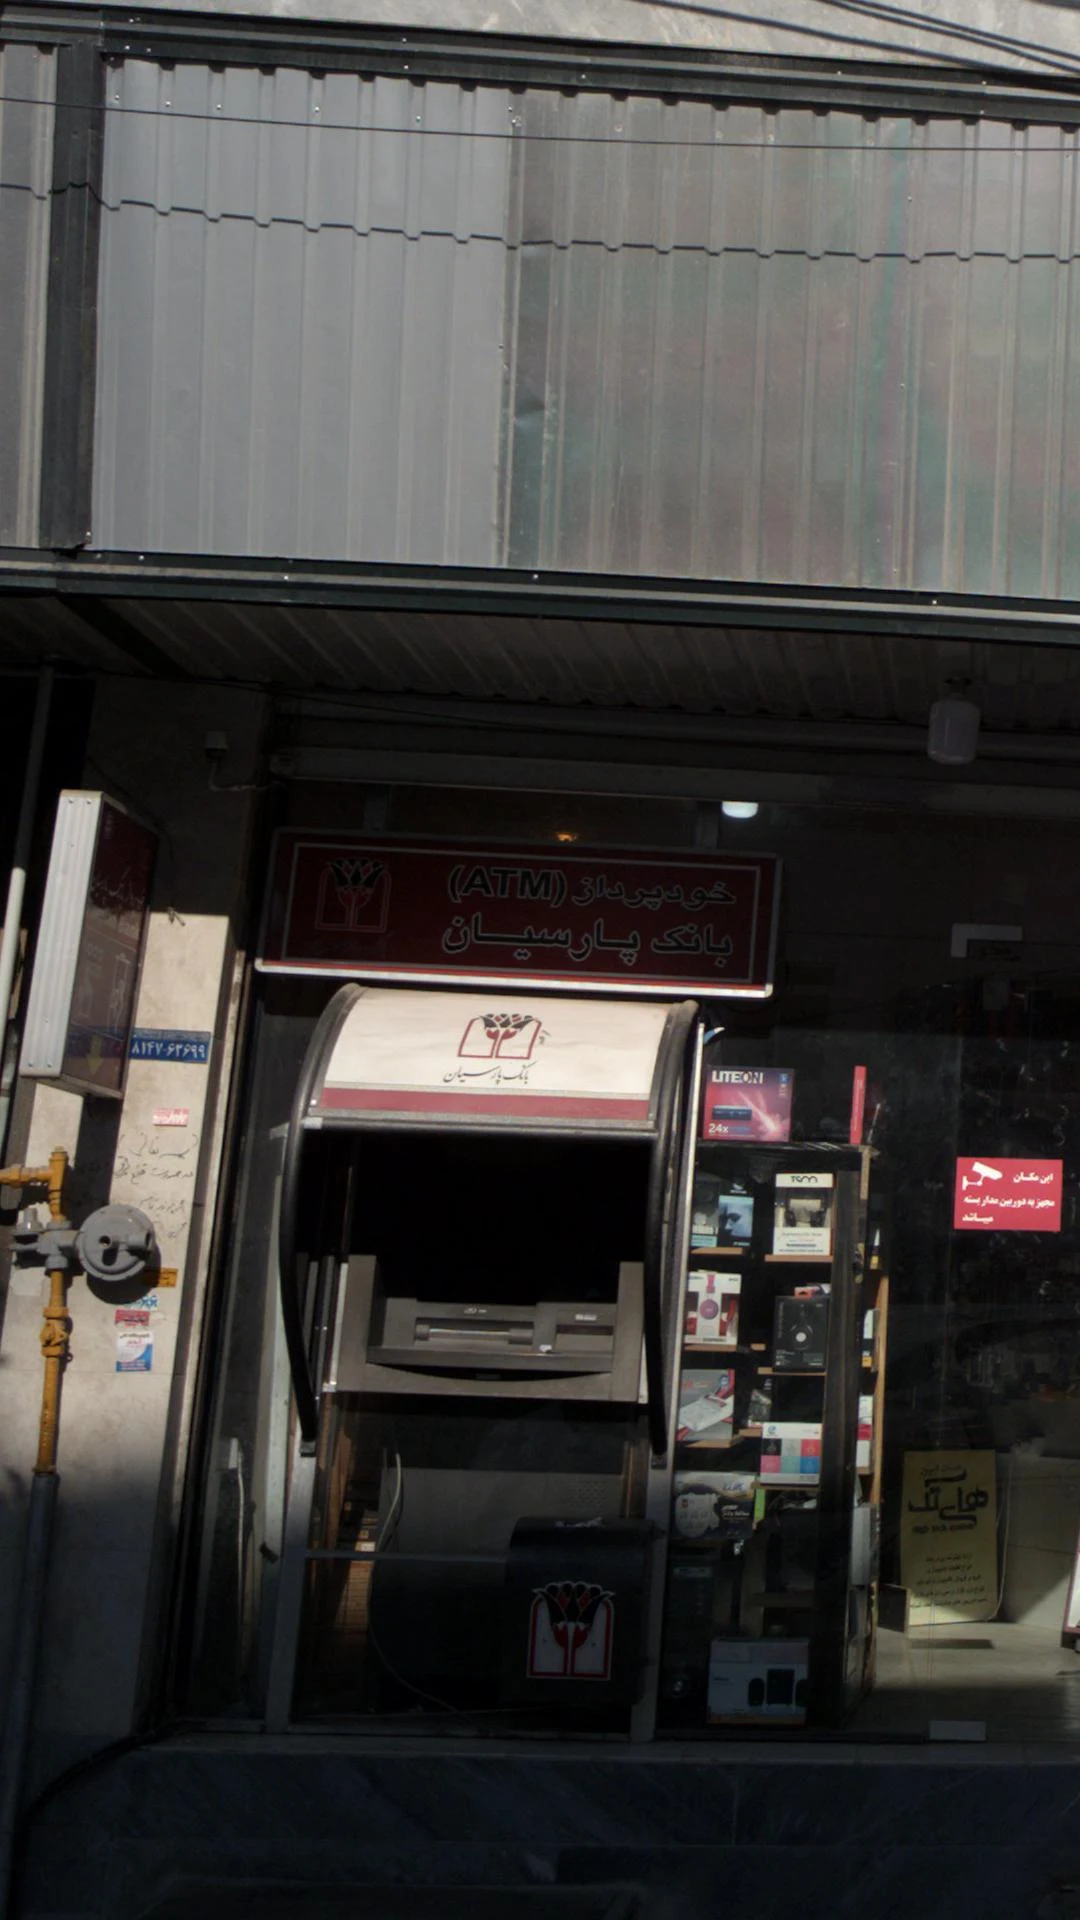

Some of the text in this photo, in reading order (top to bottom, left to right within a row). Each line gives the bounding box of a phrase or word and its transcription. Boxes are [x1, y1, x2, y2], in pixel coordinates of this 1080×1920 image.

[449, 865, 567, 908] (ATM)
[441, 912, 734, 968] بانک پارسیان
[1013, 1171, 1054, 1184] این مکان
[963, 1195, 981, 1206] بسته
[981, 1195, 999, 1207] مدار
[1027, 1198, 1035, 1208] به
[1035, 1198, 1055, 1209] مجهز
